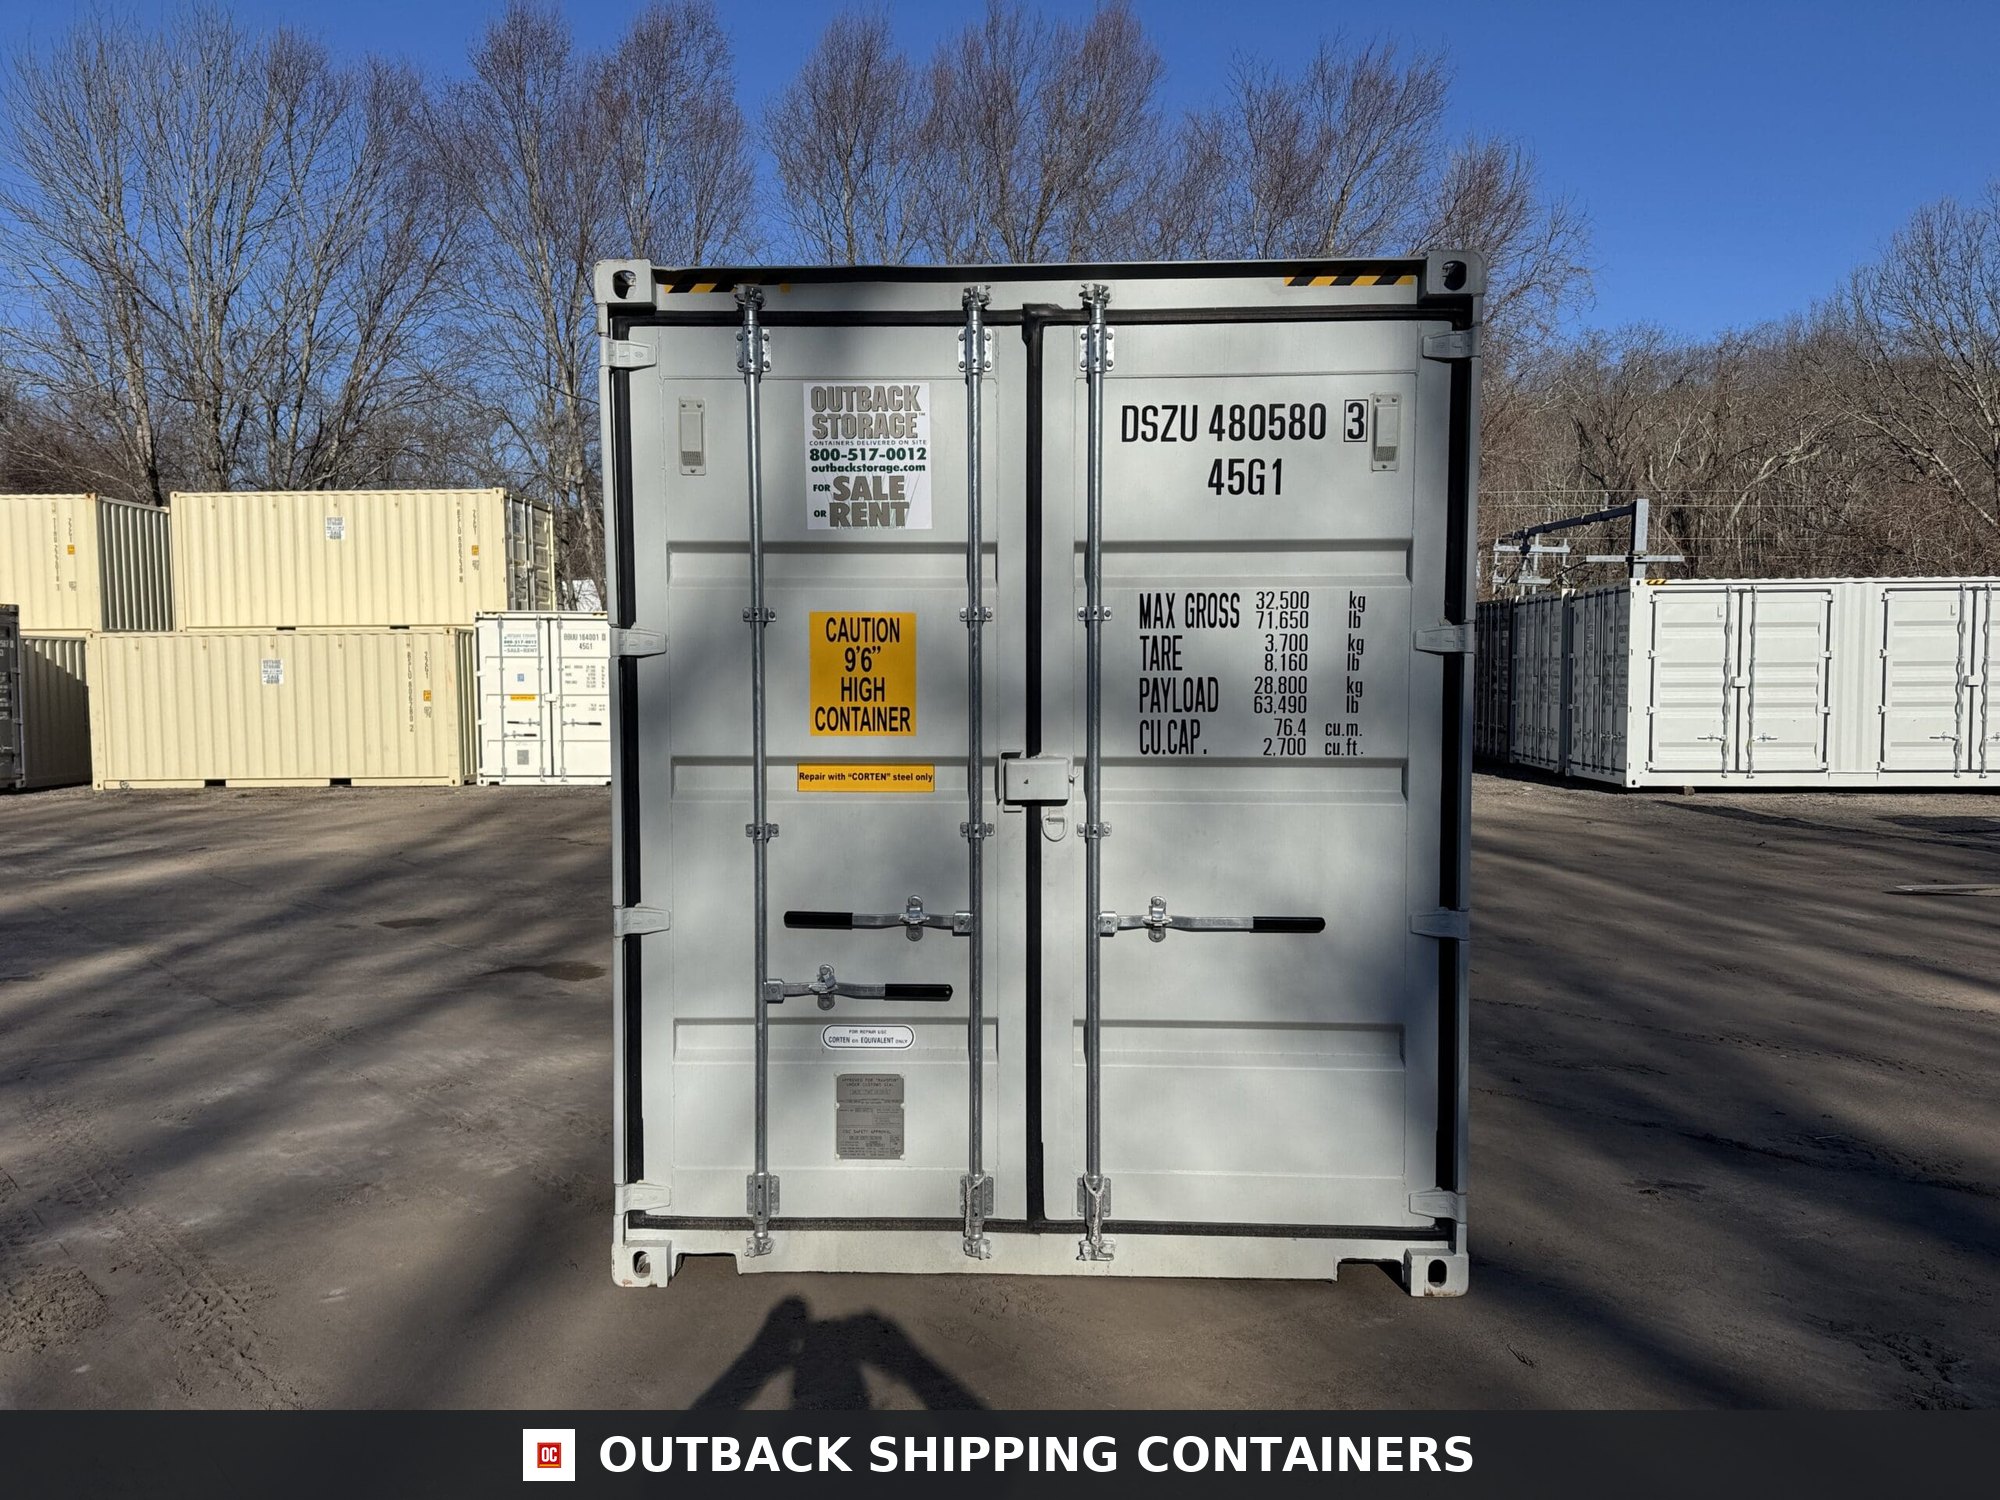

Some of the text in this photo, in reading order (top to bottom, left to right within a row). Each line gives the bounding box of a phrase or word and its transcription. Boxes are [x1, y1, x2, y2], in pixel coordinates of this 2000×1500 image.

[810, 385, 921, 412] OUTBACK
[812, 413, 918, 439] STORAGE
[1121, 402, 1364, 442] DSZU 480580 3
[809, 448, 927, 461] 800-517-0012
[811, 463, 926, 474] outbackstorage.com
[1208, 458, 1282, 495] 45G1
[813, 476, 906, 501] FOR SALE
[829, 502, 910, 527] RENT
[1139, 592, 1241, 629] MAX GROSS
[1256, 590, 1366, 612] 32,500 kg
[826, 617, 900, 643] CAUTION
[1256, 610, 1361, 629] 71,650 lb
[1139, 635, 1183, 671] TARE
[1265, 633, 1365, 655] 3,700 kg
[1264, 653, 1360, 672] 8,160 lb
[841, 677, 885, 702] HIGH
[1139, 677, 1219, 713] PAYLOAD
[1254, 675, 1363, 698] 28,800 kg
[1254, 695, 1359, 714] 63,490 lb
[815, 706, 911, 732] CONTAINER
[1274, 718, 1362, 737] 76.4 cu.m.
[1263, 738, 1364, 756] 2,700 cu.ft.
[799, 772, 825, 782] Repair
[828, 773, 846, 781] with
[892, 773, 913, 781] steel
[915, 773, 933, 782] only
[828, 1036, 850, 1044] CORTEN
